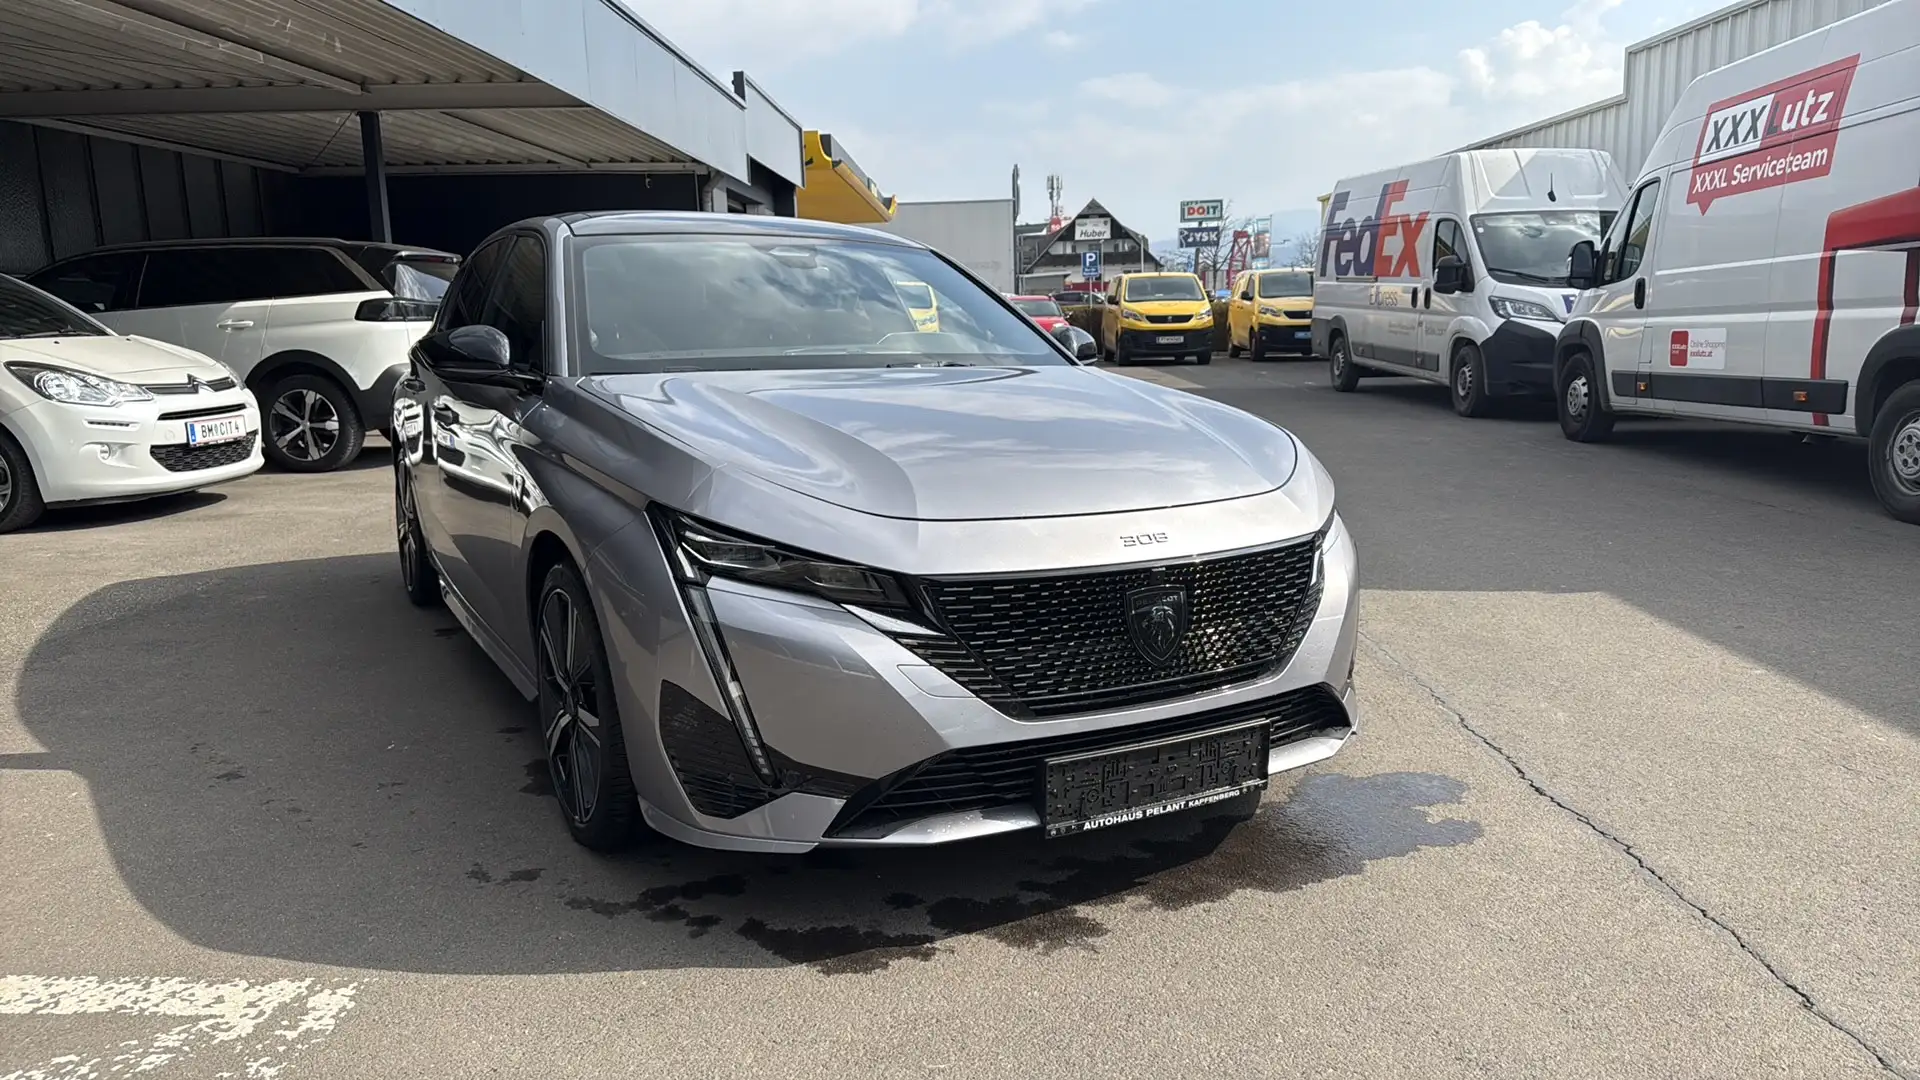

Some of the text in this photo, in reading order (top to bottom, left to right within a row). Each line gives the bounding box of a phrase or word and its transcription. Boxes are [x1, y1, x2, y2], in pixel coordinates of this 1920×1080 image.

[1705, 89, 1834, 153] XXXLutz
[1692, 148, 1828, 194] XXXL Serviceteam
[1079, 230, 1107, 238] Huber
[1187, 231, 1218, 243] JYSK
[1319, 179, 1431, 278] FedEx
[1086, 253, 1097, 267] P
[201, 424, 214, 438] BM
[1083, 790, 1240, 831] AUTOHAUS PELANT KAPFENBERG
